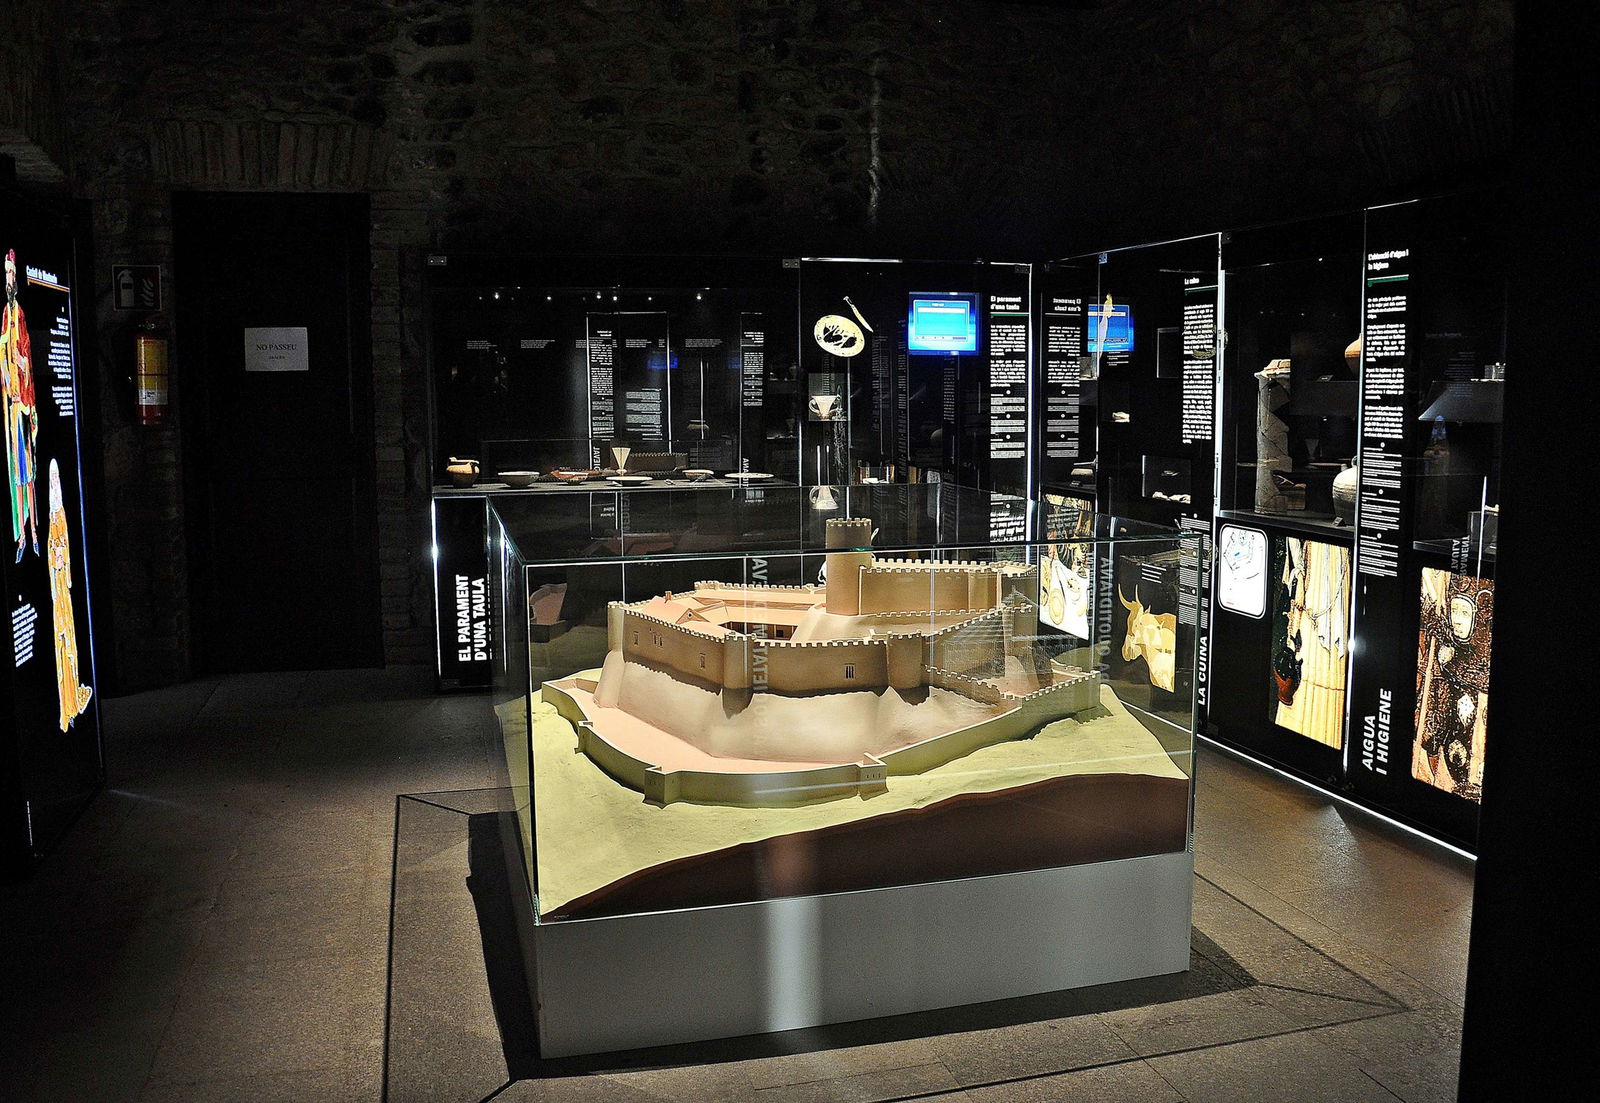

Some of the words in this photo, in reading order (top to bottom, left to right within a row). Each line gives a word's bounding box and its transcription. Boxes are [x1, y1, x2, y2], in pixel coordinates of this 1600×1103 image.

[456, 574, 471, 643] PARAMENT
[471, 577, 486, 619] TAULA
[459, 646, 472, 661] EL
[472, 620, 487, 661] D'UNA
[1198, 636, 1208, 682] CUINA
[1198, 687, 1206, 706] LA
[1362, 715, 1376, 771] AIGUA
[1376, 688, 1392, 764] HIGIENE
[1375, 767, 1387, 775] I
